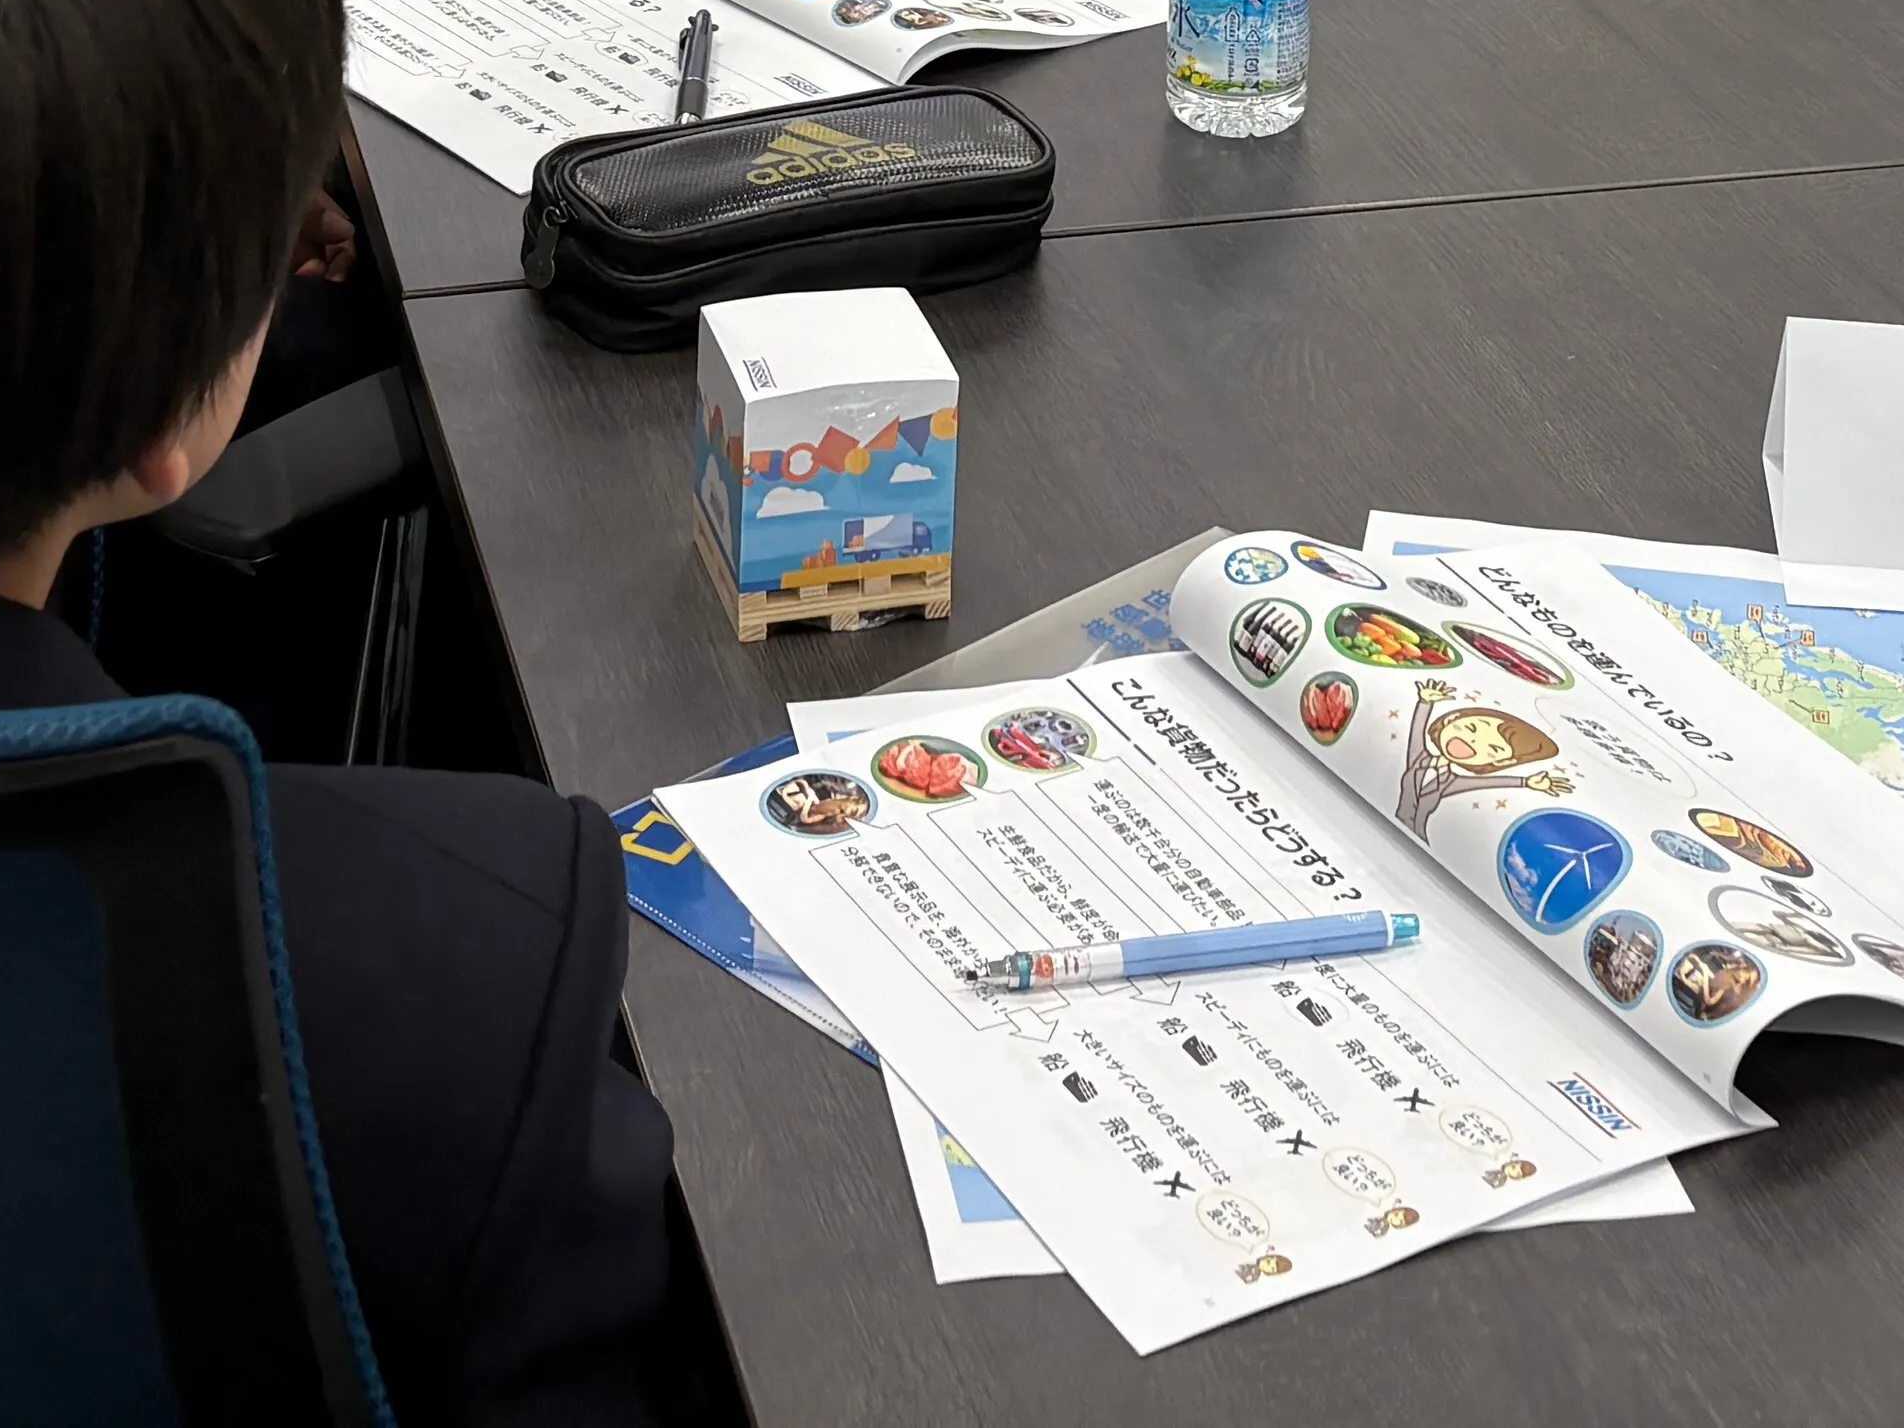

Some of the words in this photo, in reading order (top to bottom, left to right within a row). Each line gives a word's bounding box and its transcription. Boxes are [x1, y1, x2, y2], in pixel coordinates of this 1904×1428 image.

[746, 142, 916, 185] adidas
[1478, 565, 1734, 763] どんなものを運んでいるの？
[1111, 677, 1363, 903] こんな貨物だったらどうする？
[976, 827, 1095, 944] スピーディに運ぶ必要があ
[997, 824, 1120, 941] 生鮮食品だから、鮮度が命
[1092, 778, 1248, 923] 運ぶのは数千台分の自動車部品
[872, 851, 990, 976] 貴重な展示品を、海外から
[1220, 1078, 1286, 1133] 飛行機
[1336, 1037, 1403, 1092] 飛行機
[1557, 1078, 1633, 1132] NISSIN
[1100, 1116, 1164, 1174] 飛行機
